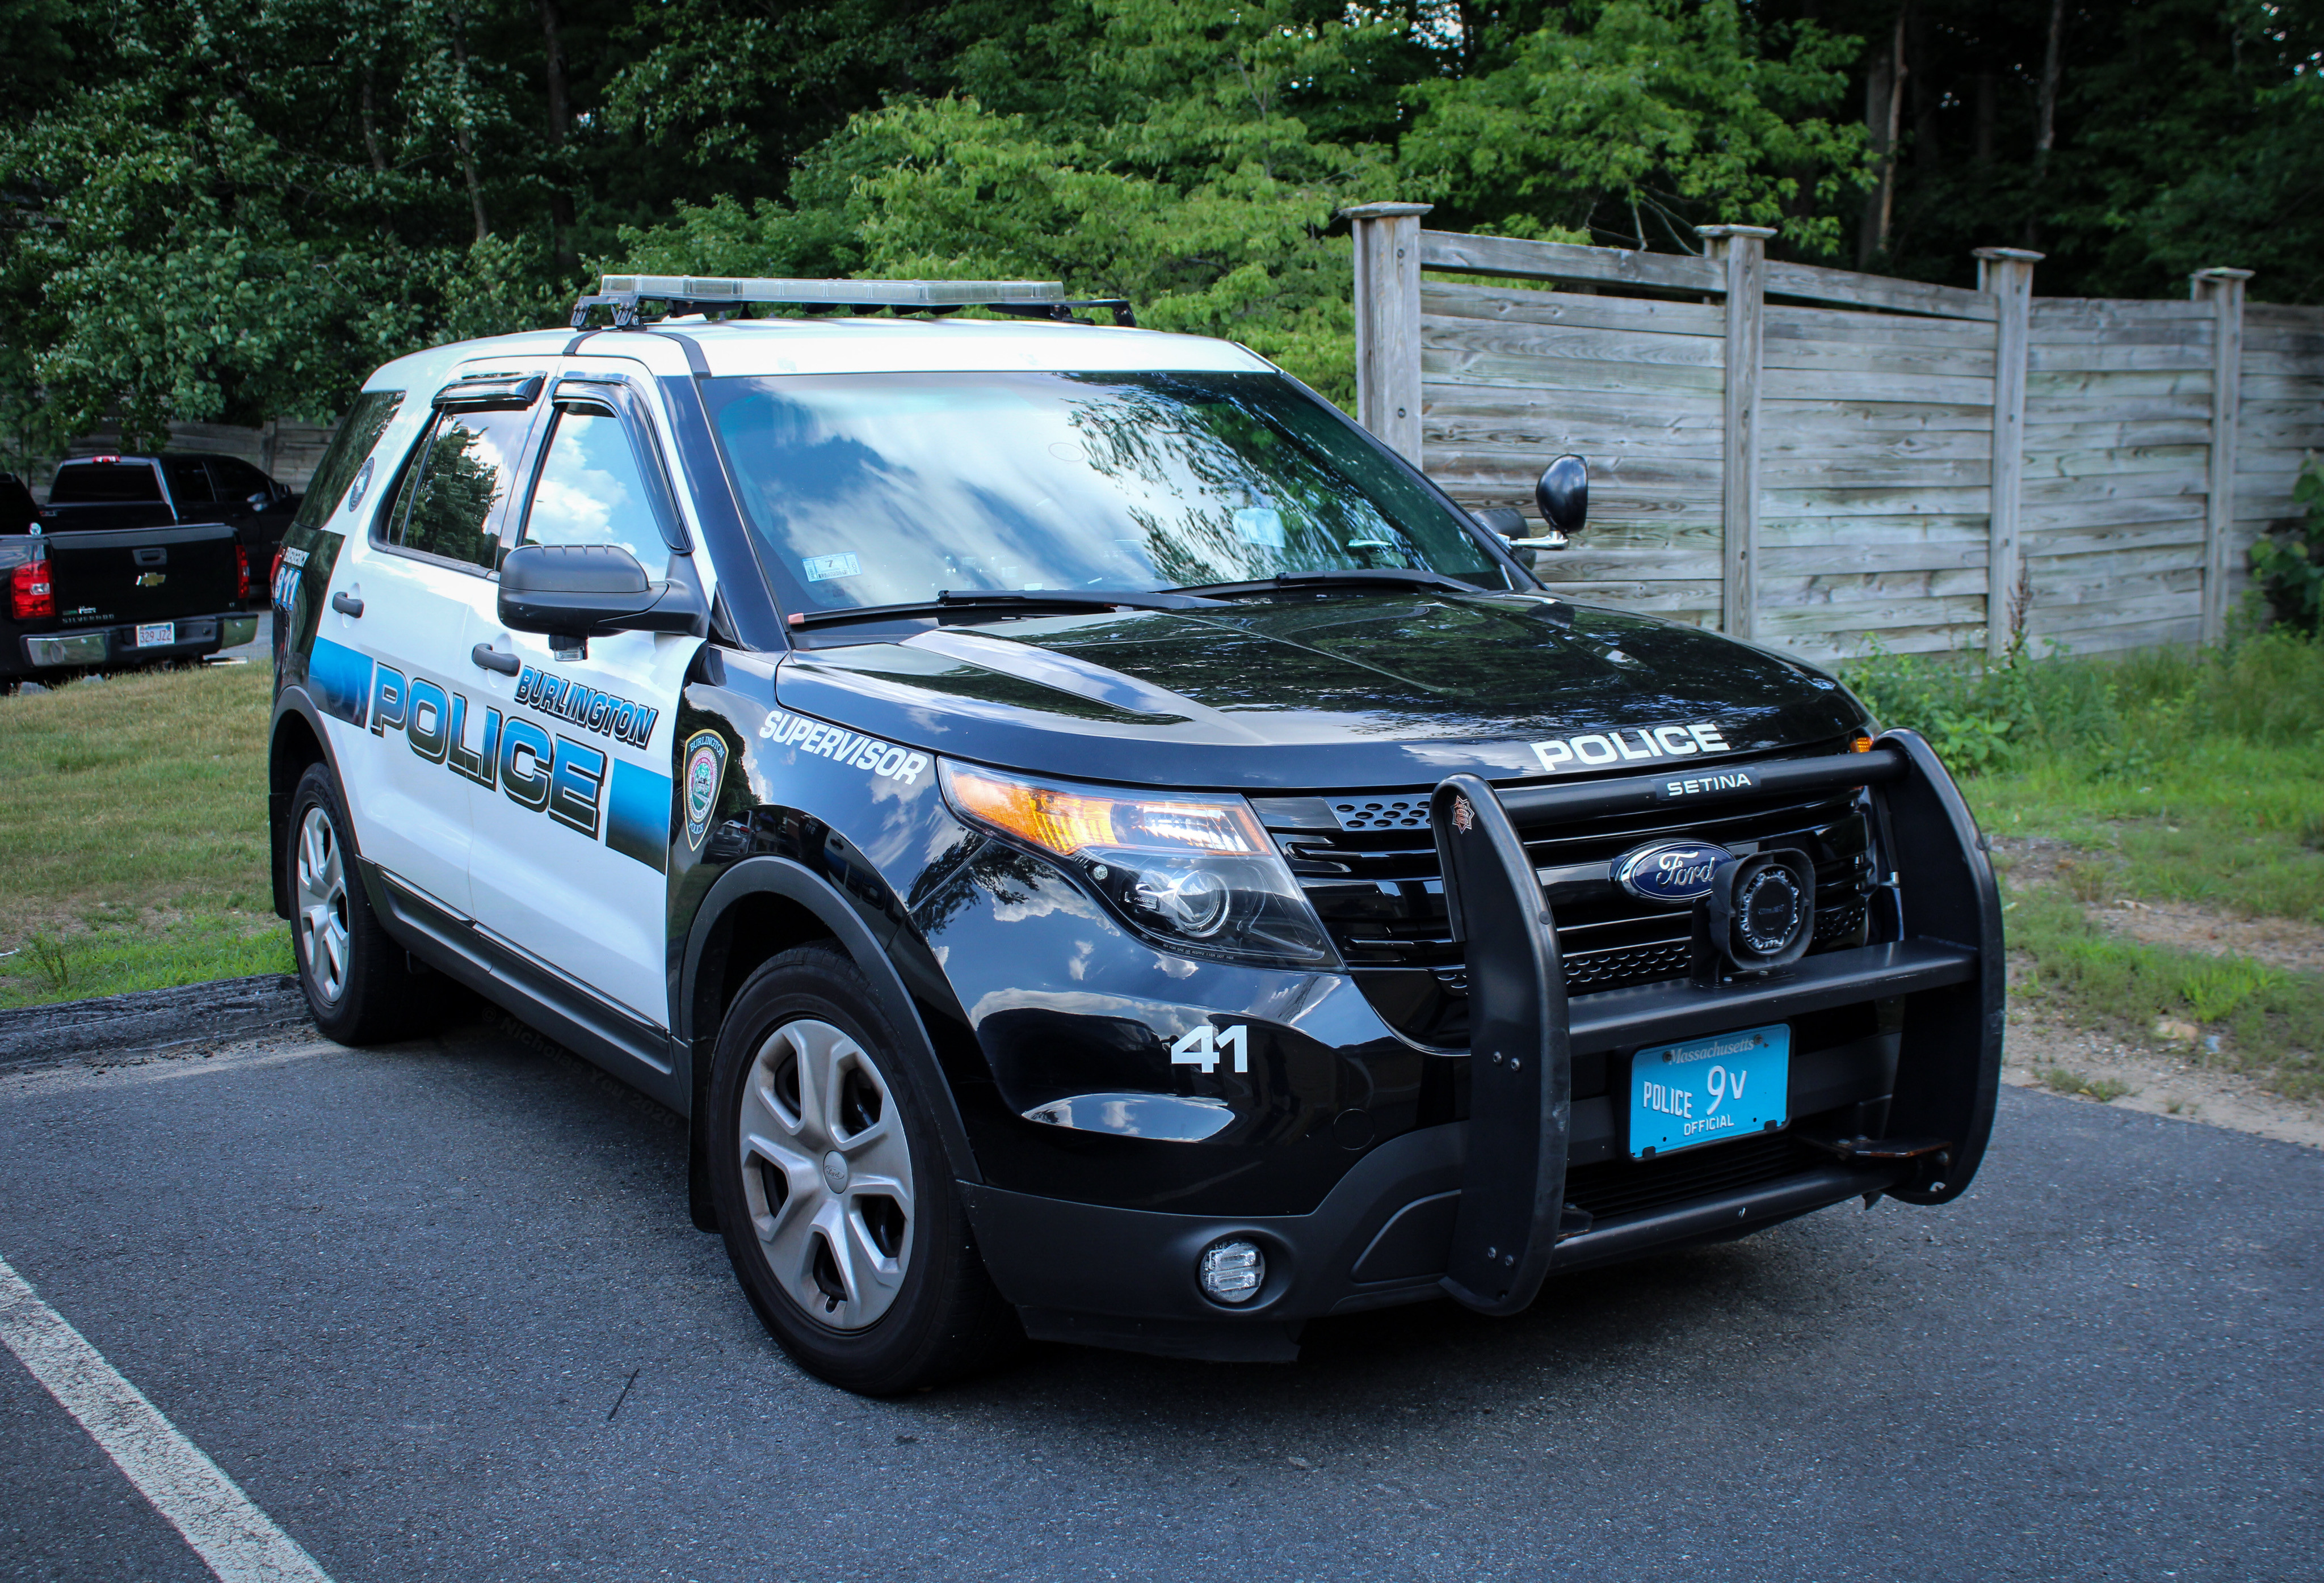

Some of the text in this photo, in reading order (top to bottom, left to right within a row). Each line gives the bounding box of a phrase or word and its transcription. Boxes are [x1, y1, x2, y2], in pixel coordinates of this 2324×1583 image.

[275, 565, 301, 611] 911
[62, 613, 115, 623] SILVERADO
[514, 664, 659, 751] BURLINGTON
[370, 659, 607, 841] POLICE
[690, 736, 725, 758] BURLINGTON
[759, 710, 928, 785] SUPERVISOR
[1529, 723, 1731, 772] POLICE
[1667, 773, 1752, 796] SETINA
[688, 819, 704, 835] POLICE
[1656, 852, 1715, 886] Ford
[1171, 1025, 1248, 1073] 41
[1669, 1037, 1754, 1065] Massachusetts
[1644, 1081, 1692, 1119] POLICE
[1684, 1113, 1735, 1136] OFFICIAL
